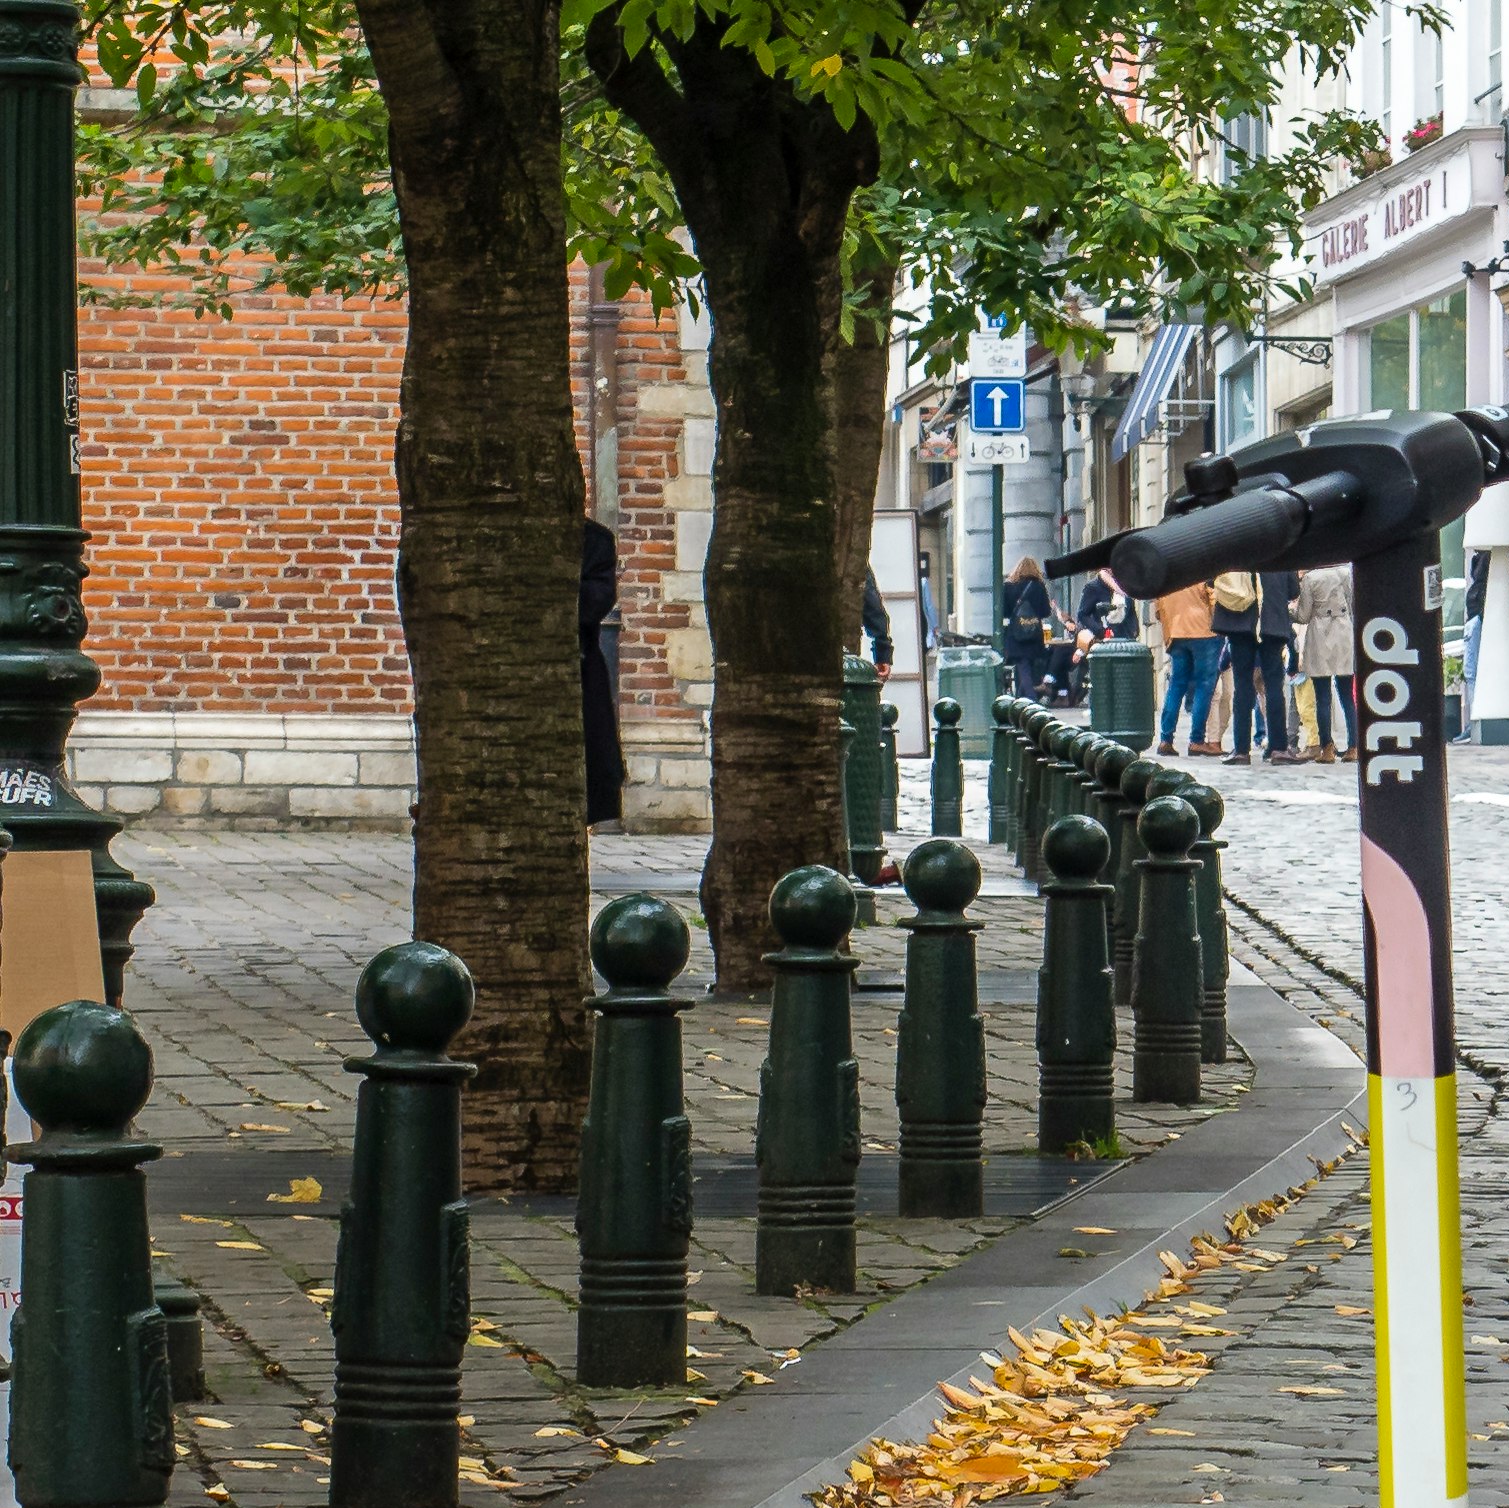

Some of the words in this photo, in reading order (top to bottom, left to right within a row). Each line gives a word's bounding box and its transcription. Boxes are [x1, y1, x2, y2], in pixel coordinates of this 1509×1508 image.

[1322, 213, 1369, 268] GALERIE
[1384, 179, 1431, 240] ALBERT
[1361, 616, 1424, 786] dott
[1396, 1082, 1418, 1111] 3
